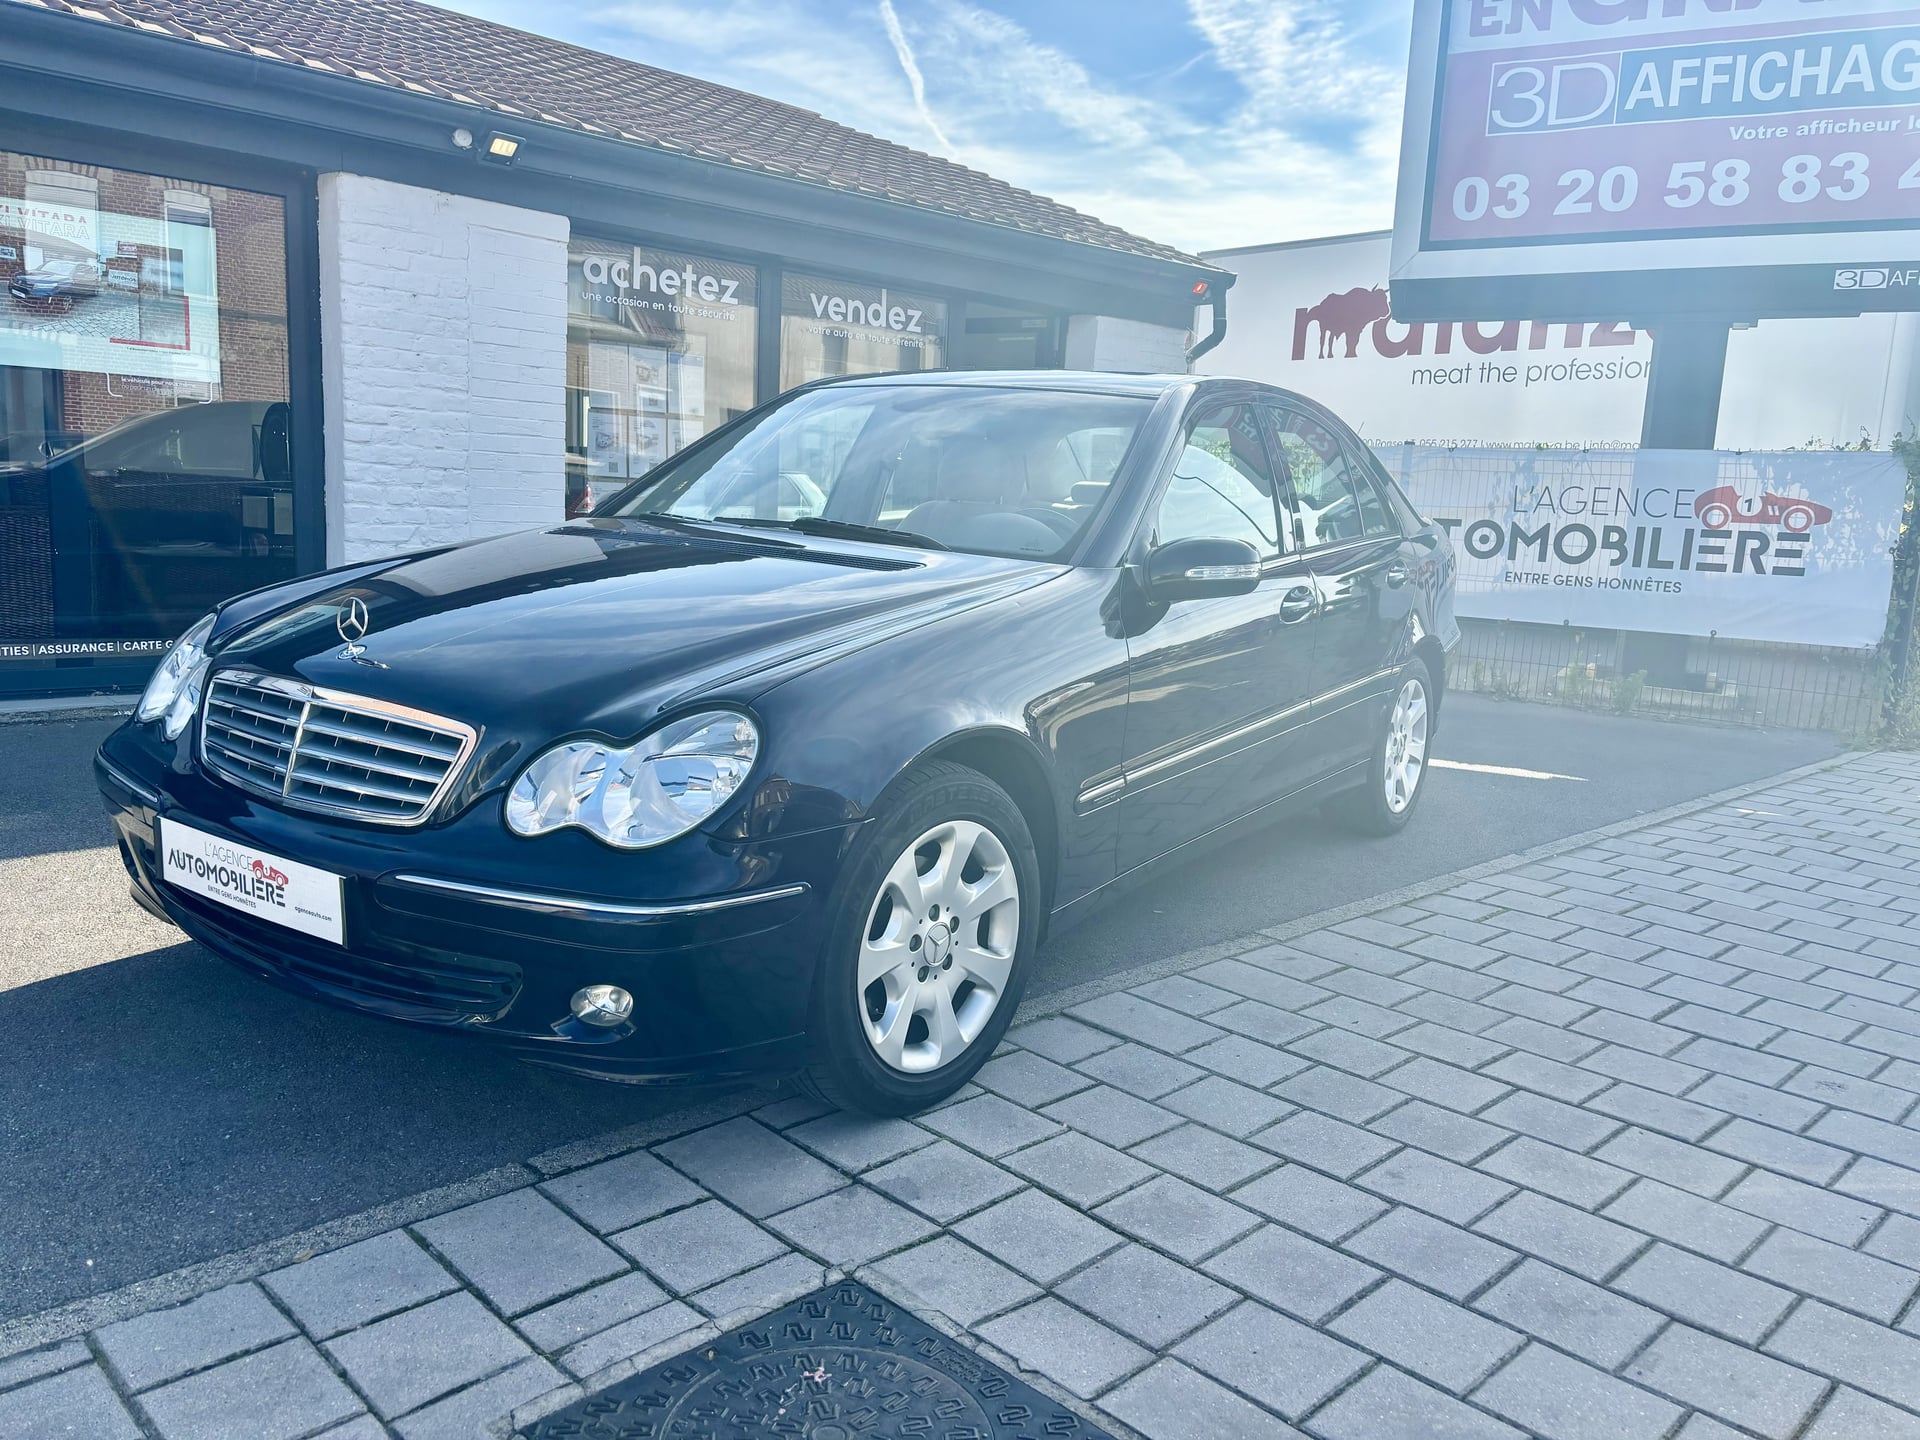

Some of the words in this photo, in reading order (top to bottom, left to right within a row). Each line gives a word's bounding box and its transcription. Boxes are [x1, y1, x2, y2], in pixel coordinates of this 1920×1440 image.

[1469, 0, 1553, 37] EN
[1491, 62, 1616, 128] 3D
[1729, 125, 1789, 141] Votre
[1796, 119, 1901, 136] afficheur
[1452, 173, 1531, 221] 03
[1553, 166, 1638, 215] 20
[1663, 159, 1750, 208] 58
[1778, 152, 1870, 203] 83
[582, 246, 740, 305] achetez
[1835, 270, 1887, 288] 3D
[582, 291, 602, 302] une
[605, 295, 649, 309] occasion
[652, 301, 665, 311] en
[668, 303, 695, 316] toute
[809, 288, 923, 333] vendez
[808, 325, 831, 335] votre
[833, 329, 853, 339] auto
[868, 334, 891, 344] toute
[1411, 362, 1471, 385] meat
[1479, 361, 1518, 384] the
[1512, 484, 1695, 520] L'AGENCE
[1505, 571, 1549, 586] ENTRE
[1553, 574, 1593, 589] GENS
[1597, 576, 1682, 594] HONNÊTES
[0, 646, 29, 656] TIES
[38, 642, 114, 655] ASSURANCE
[123, 640, 162, 651] CARTE
[204, 841, 253, 872] L'AGENCE
[168, 848, 286, 908] AUTOMOBILIERE
